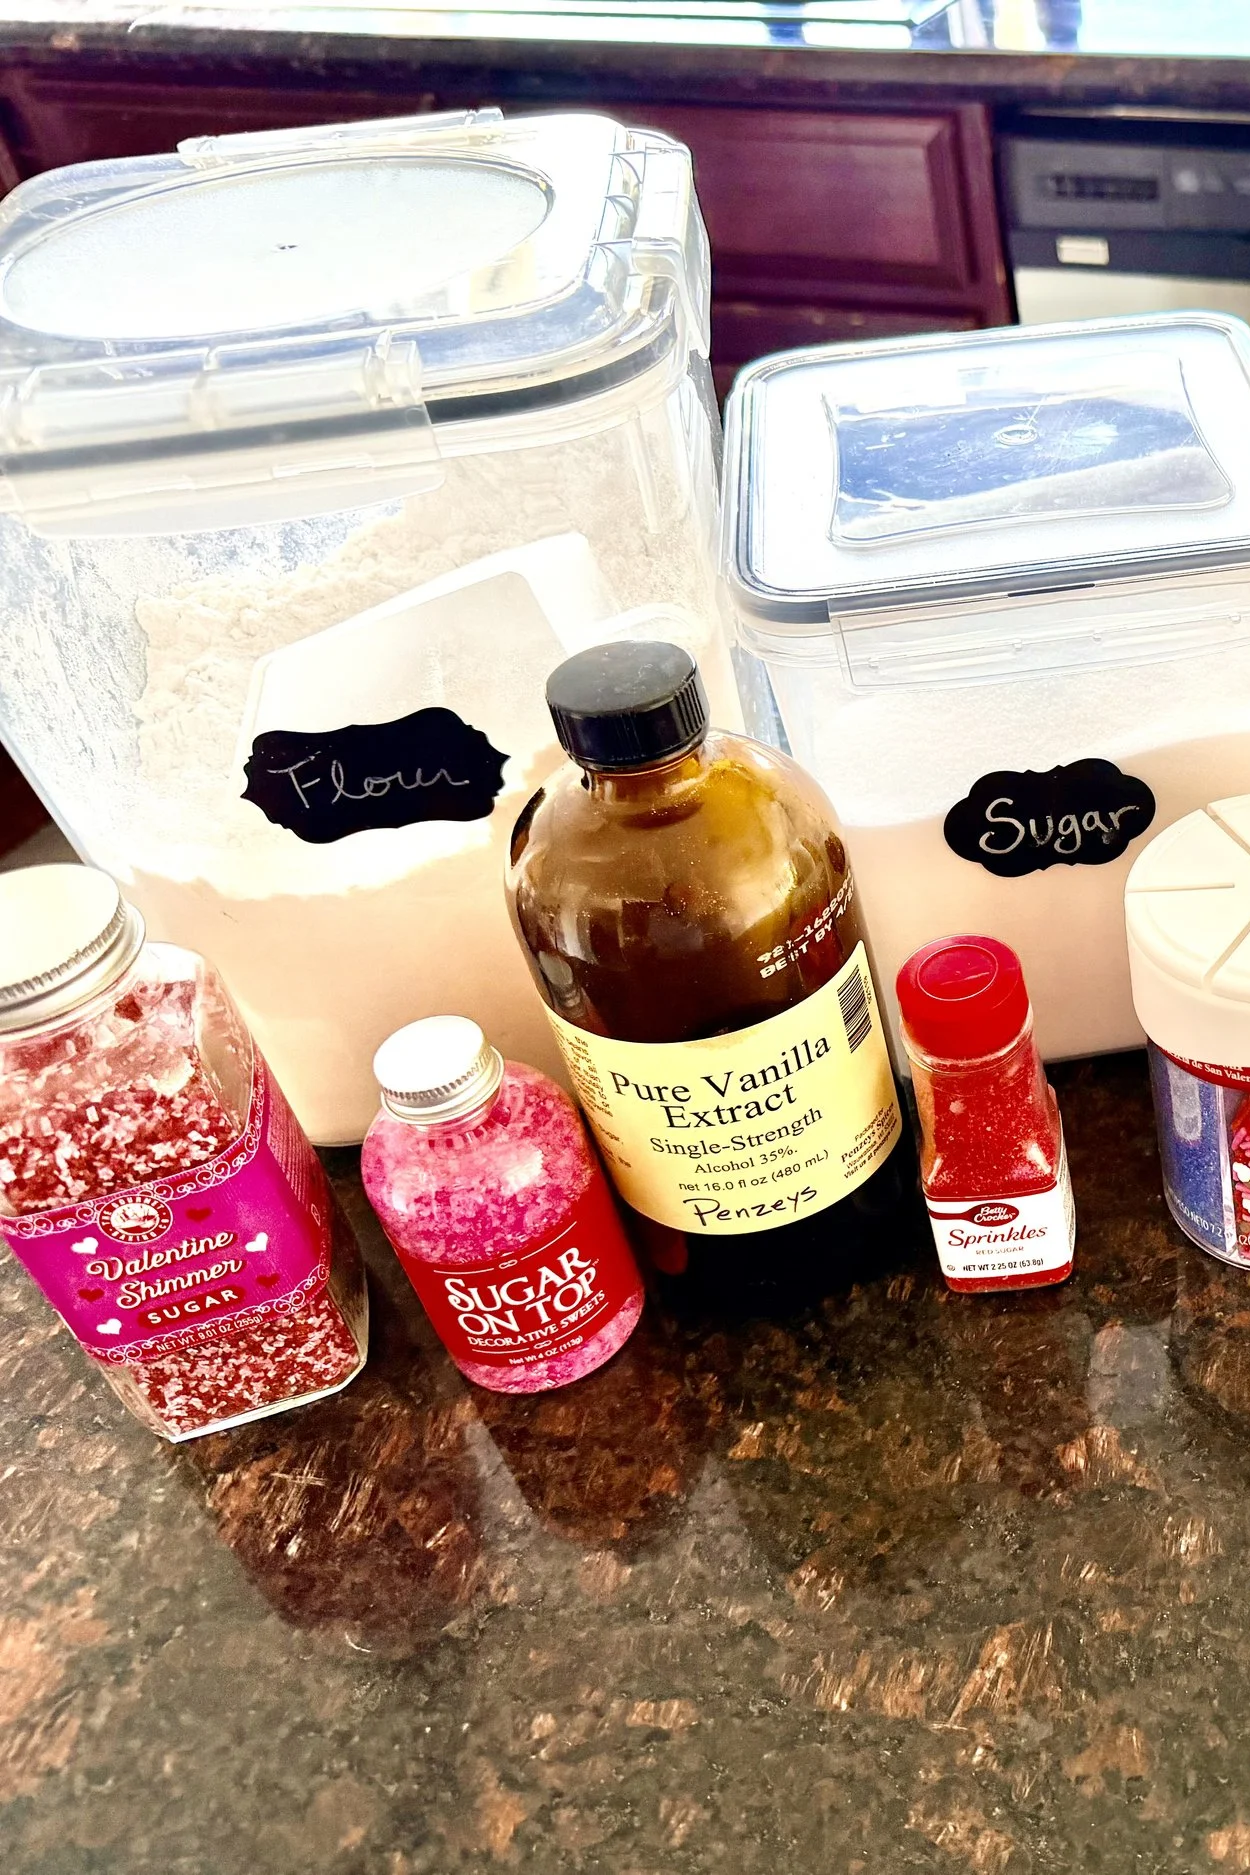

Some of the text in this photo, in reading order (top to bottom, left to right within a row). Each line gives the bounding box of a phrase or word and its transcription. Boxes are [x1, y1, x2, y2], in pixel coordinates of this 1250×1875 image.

[267, 750, 470, 809] Flour
[978, 796, 1140, 855] Sugar
[607, 1069, 693, 1103] Pure
[700, 1034, 833, 1099] Vanilla
[1204, 1062, 1223, 1077] San
[661, 1081, 799, 1129] Extract
[649, 1106, 824, 1160] Single-Strength
[678, 1148, 831, 1193] net 16.0 fl oz (480 mL)
[694, 1146, 800, 1175] Alcohol 35%.
[682, 1184, 819, 1228] Penzeys
[973, 1212, 1014, 1224] Crocker
[980, 1206, 1008, 1216] Betty
[86, 1231, 236, 1282] Valentine
[947, 1224, 1049, 1249] Sprinkles
[115, 1257, 244, 1310] Shimmer
[444, 1246, 592, 1313] SUGAR
[962, 1264, 977, 1272] NET
[978, 1263, 990, 1272] WT
[1007, 1261, 1018, 1270] OZ
[147, 1289, 239, 1324] SUGAR
[457, 1266, 597, 1336] ON TOP
[466, 1289, 606, 1348] DECORATIVE SWEETS
[156, 1341, 177, 1353] NET
[218, 1322, 233, 1334] OZ
[233, 1313, 264, 1330] (255g)
[544, 1347, 559, 1357] OZ
